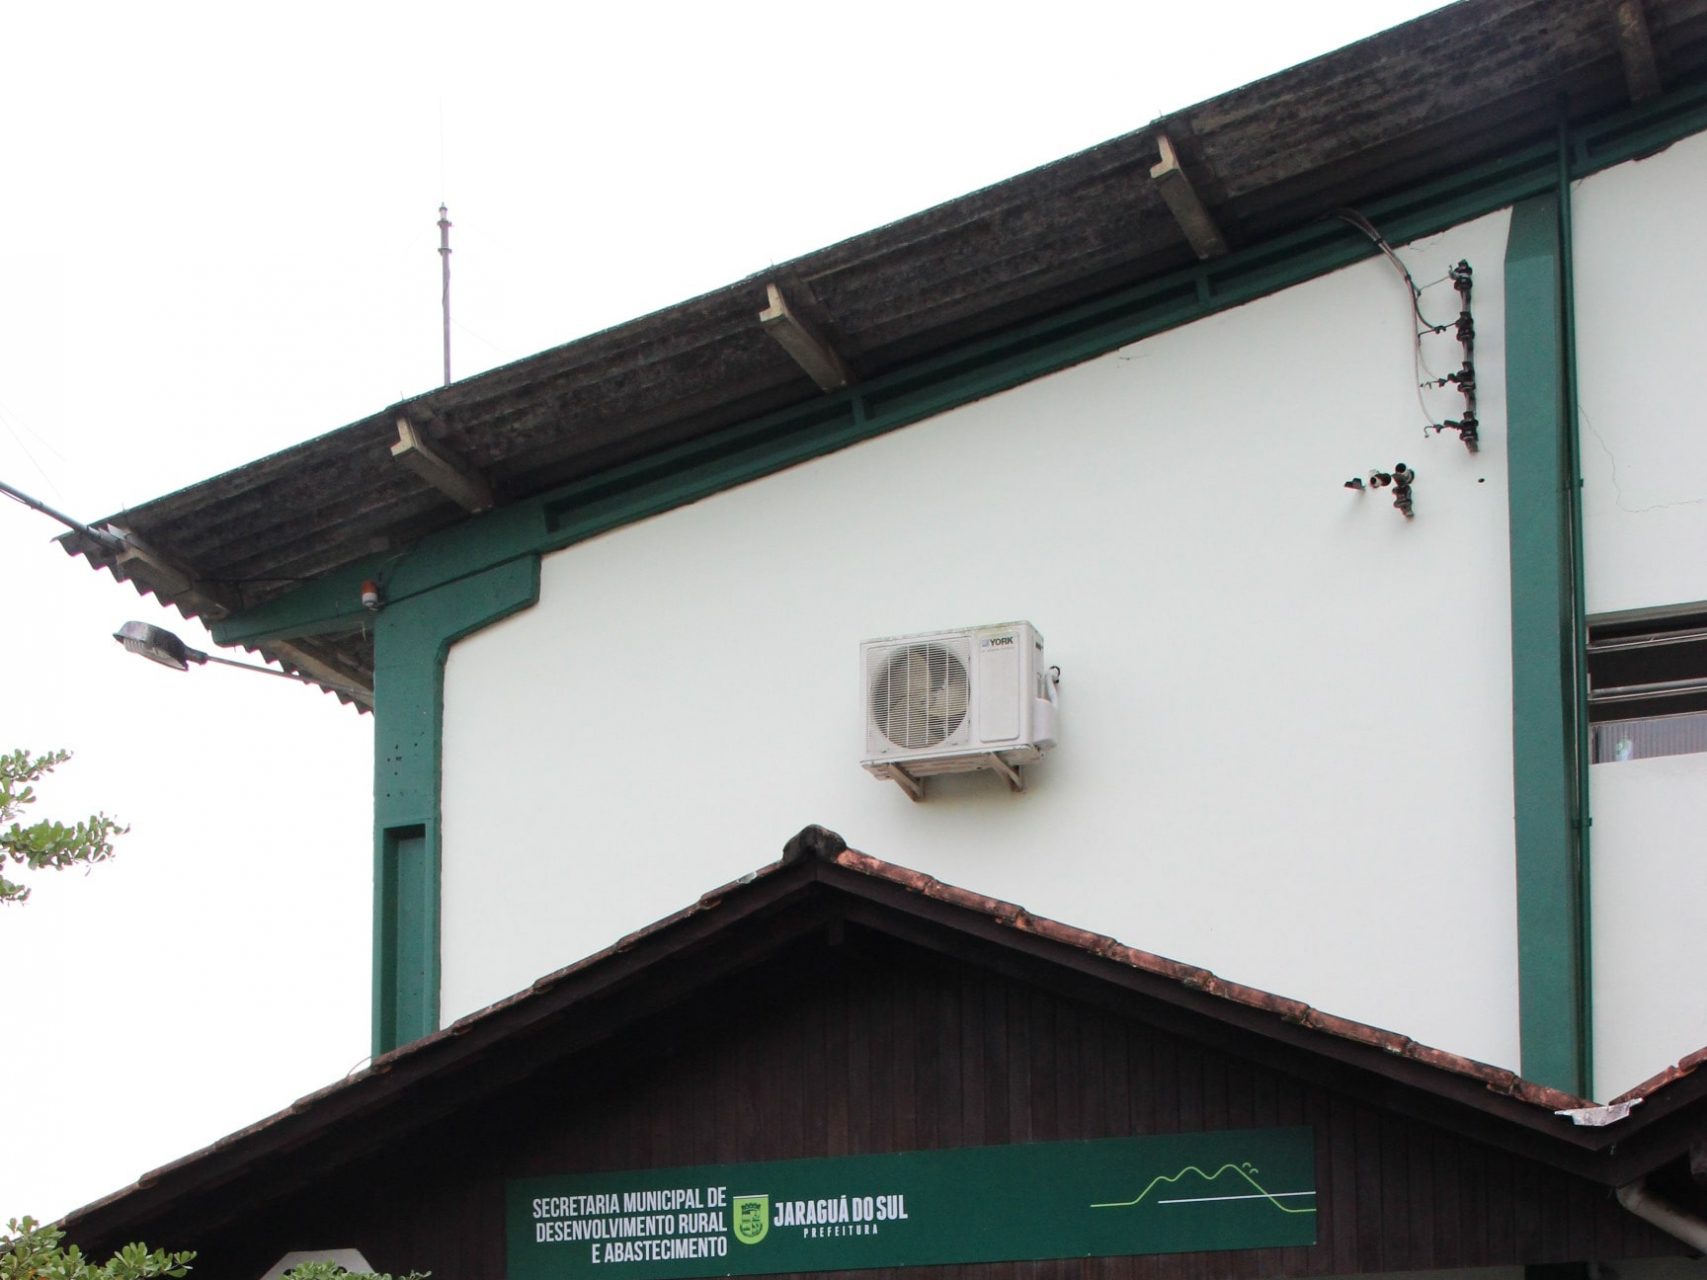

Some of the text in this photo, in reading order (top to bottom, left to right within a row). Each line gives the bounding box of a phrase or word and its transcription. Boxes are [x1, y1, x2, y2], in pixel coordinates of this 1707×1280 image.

[990, 636, 1014, 646] YORK
[533, 1186, 727, 1218] SECRETARIA MUNICIPAL DE
[773, 1194, 908, 1227] JARAGUÁ DO SUL
[536, 1211, 728, 1243] DESENVOLVIMENTO RURAL
[803, 1224, 878, 1239] PREFEITURA
[592, 1236, 728, 1264] E ABASTECIMENTO
